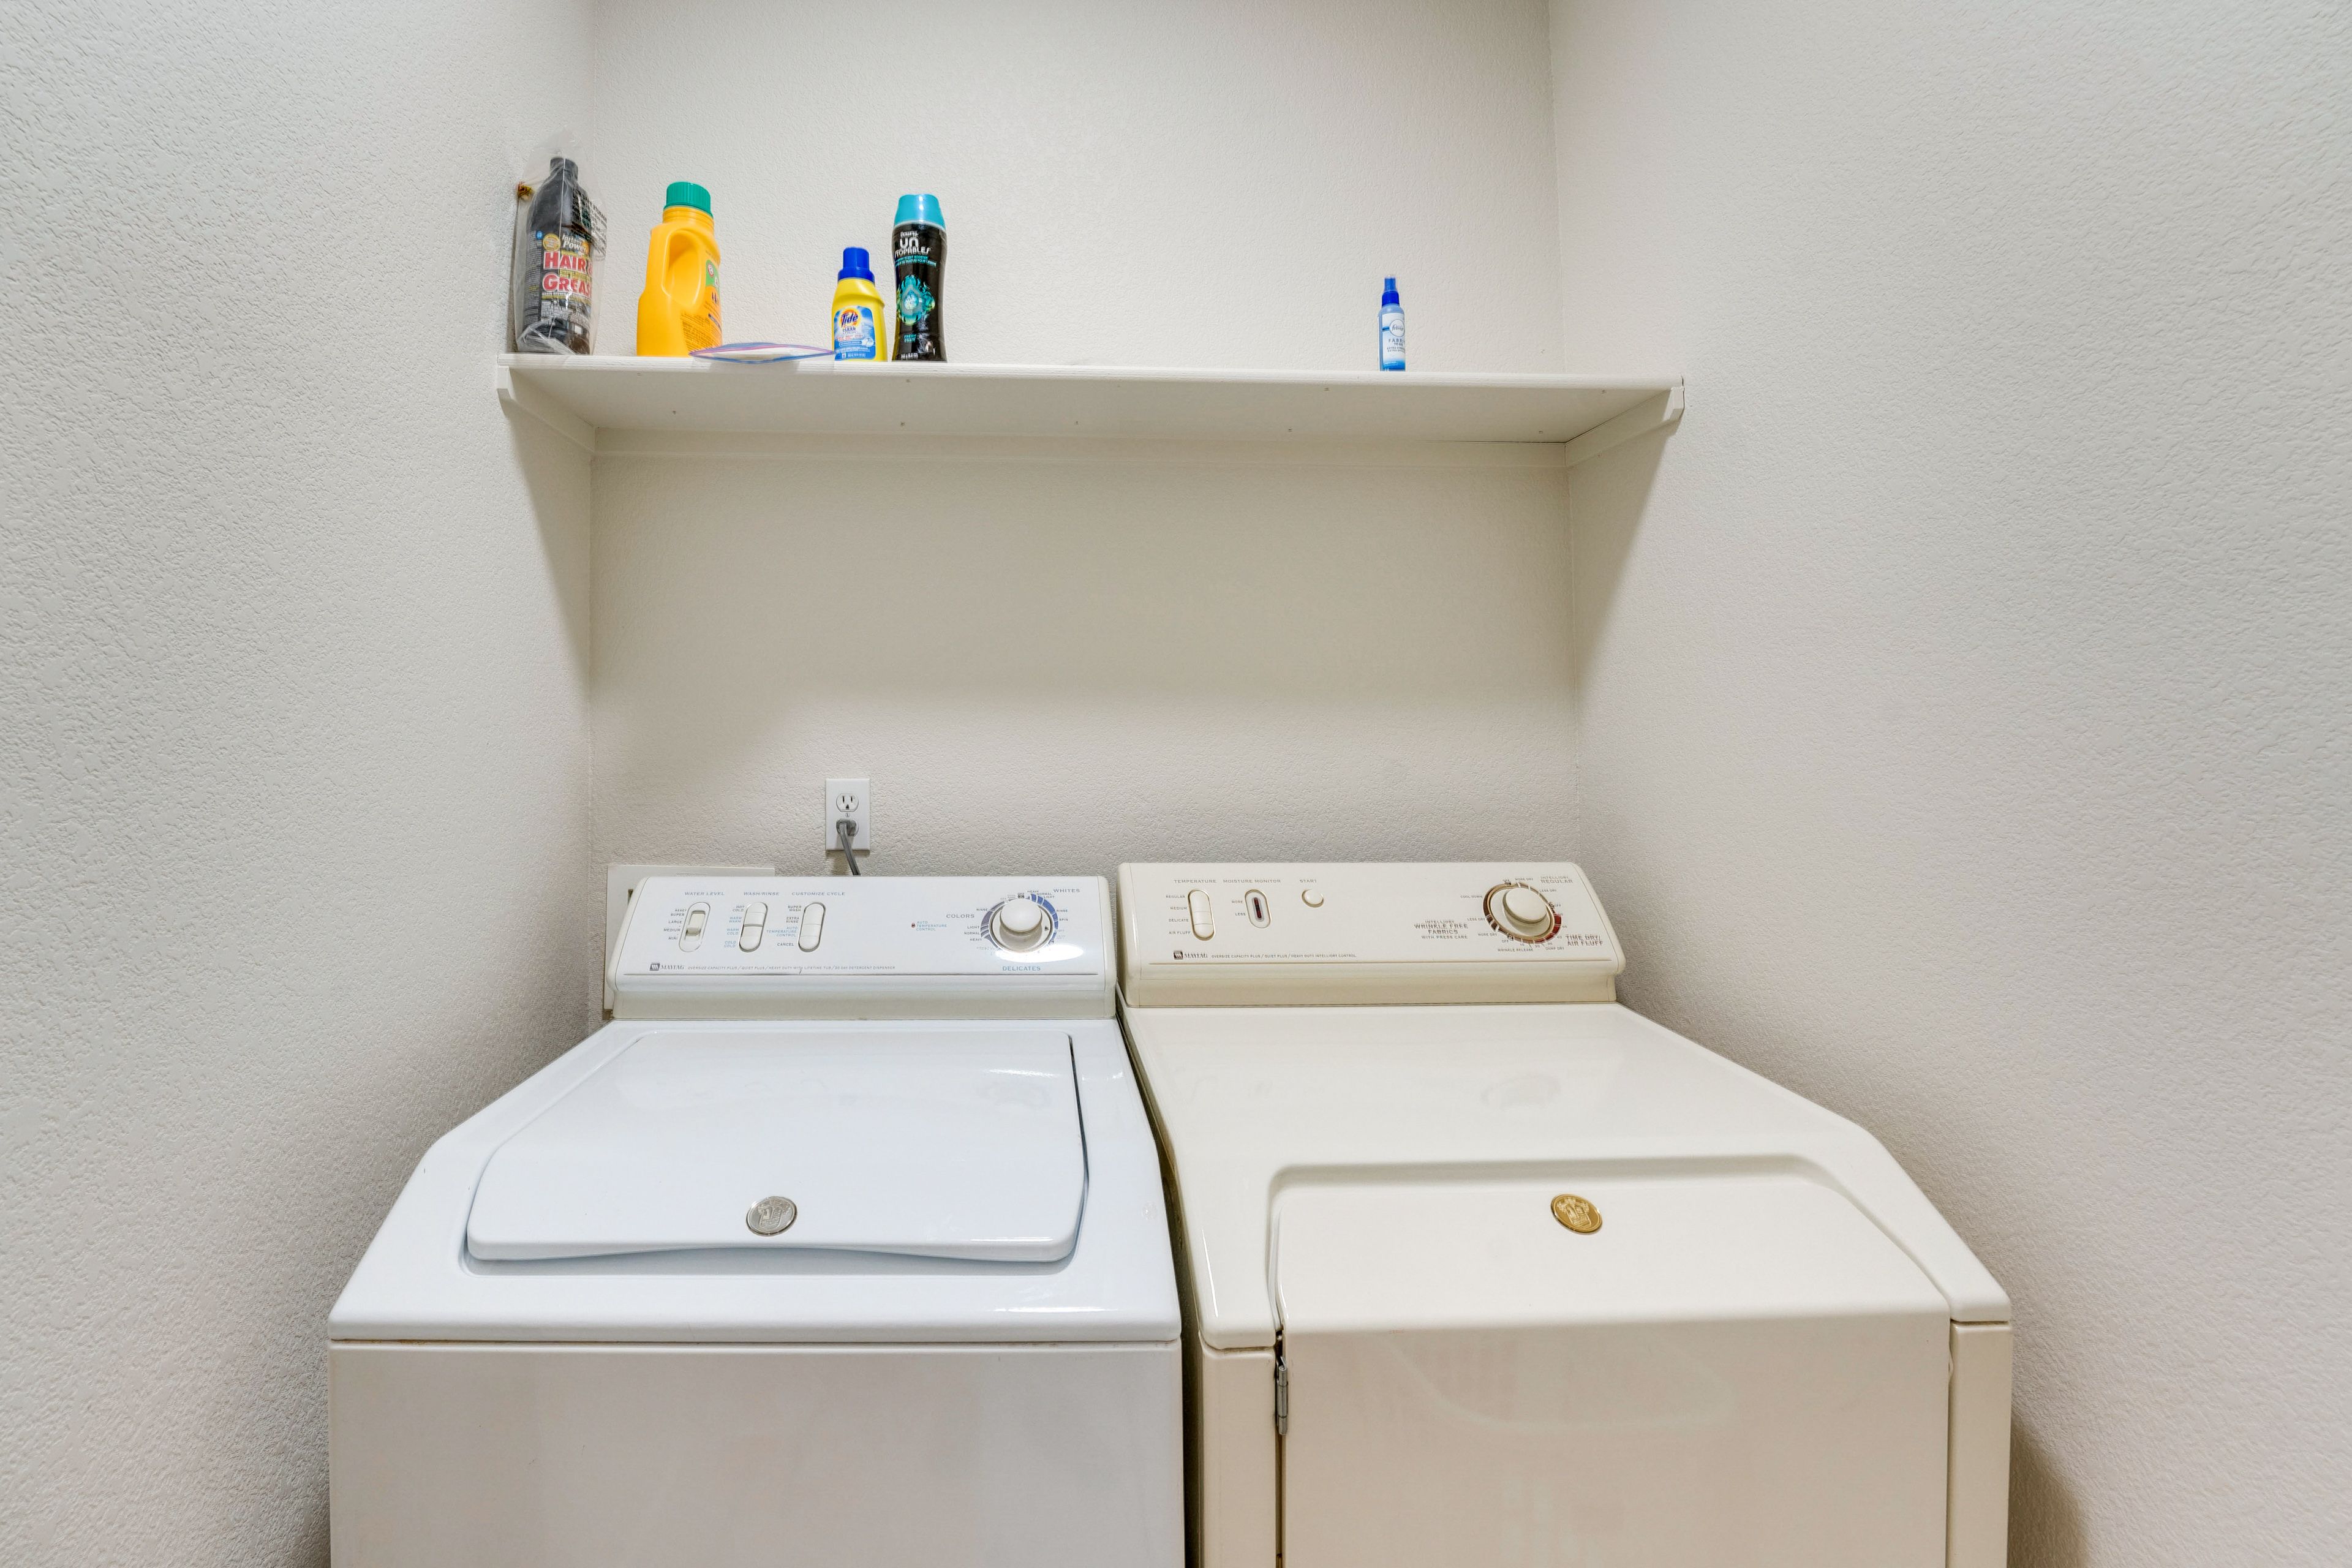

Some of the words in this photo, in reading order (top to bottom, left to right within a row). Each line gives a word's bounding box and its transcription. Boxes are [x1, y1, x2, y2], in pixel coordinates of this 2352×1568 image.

[562, 235, 582, 244] Instant
[563, 241, 587, 252] Power
[543, 251, 587, 273] HAIR
[841, 312, 858, 326] Tide
